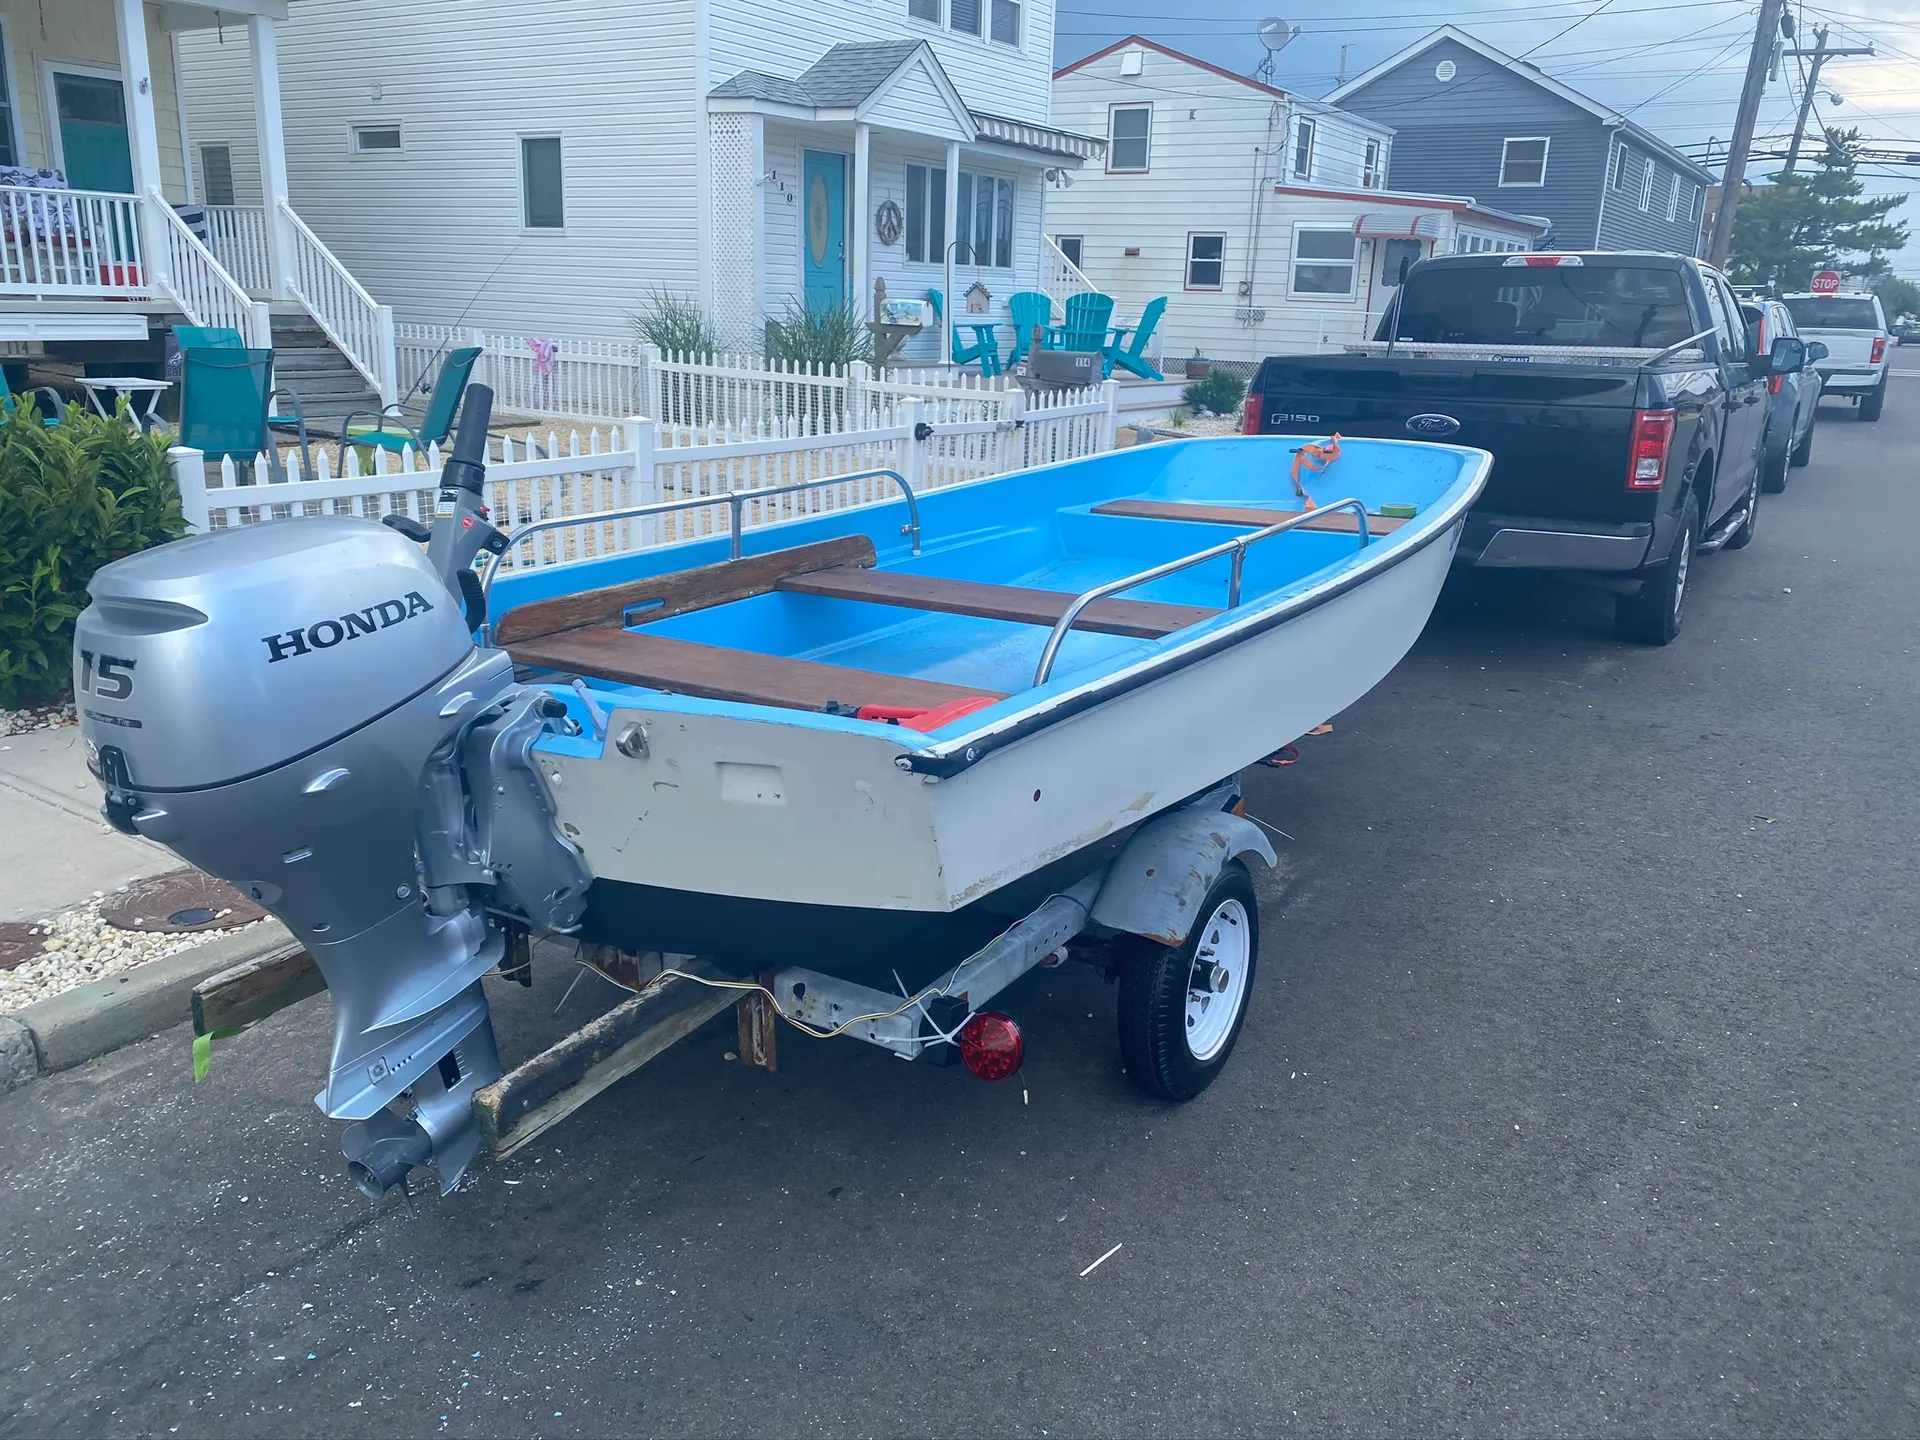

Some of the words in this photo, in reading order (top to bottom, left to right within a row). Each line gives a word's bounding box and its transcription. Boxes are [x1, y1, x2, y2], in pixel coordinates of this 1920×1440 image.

[771, 169, 793, 203] 110
[1813, 278, 1839, 290] STOP
[261, 590, 435, 664] HONDA
[79, 648, 138, 702] 15
[116, 717, 131, 727] Tilt
